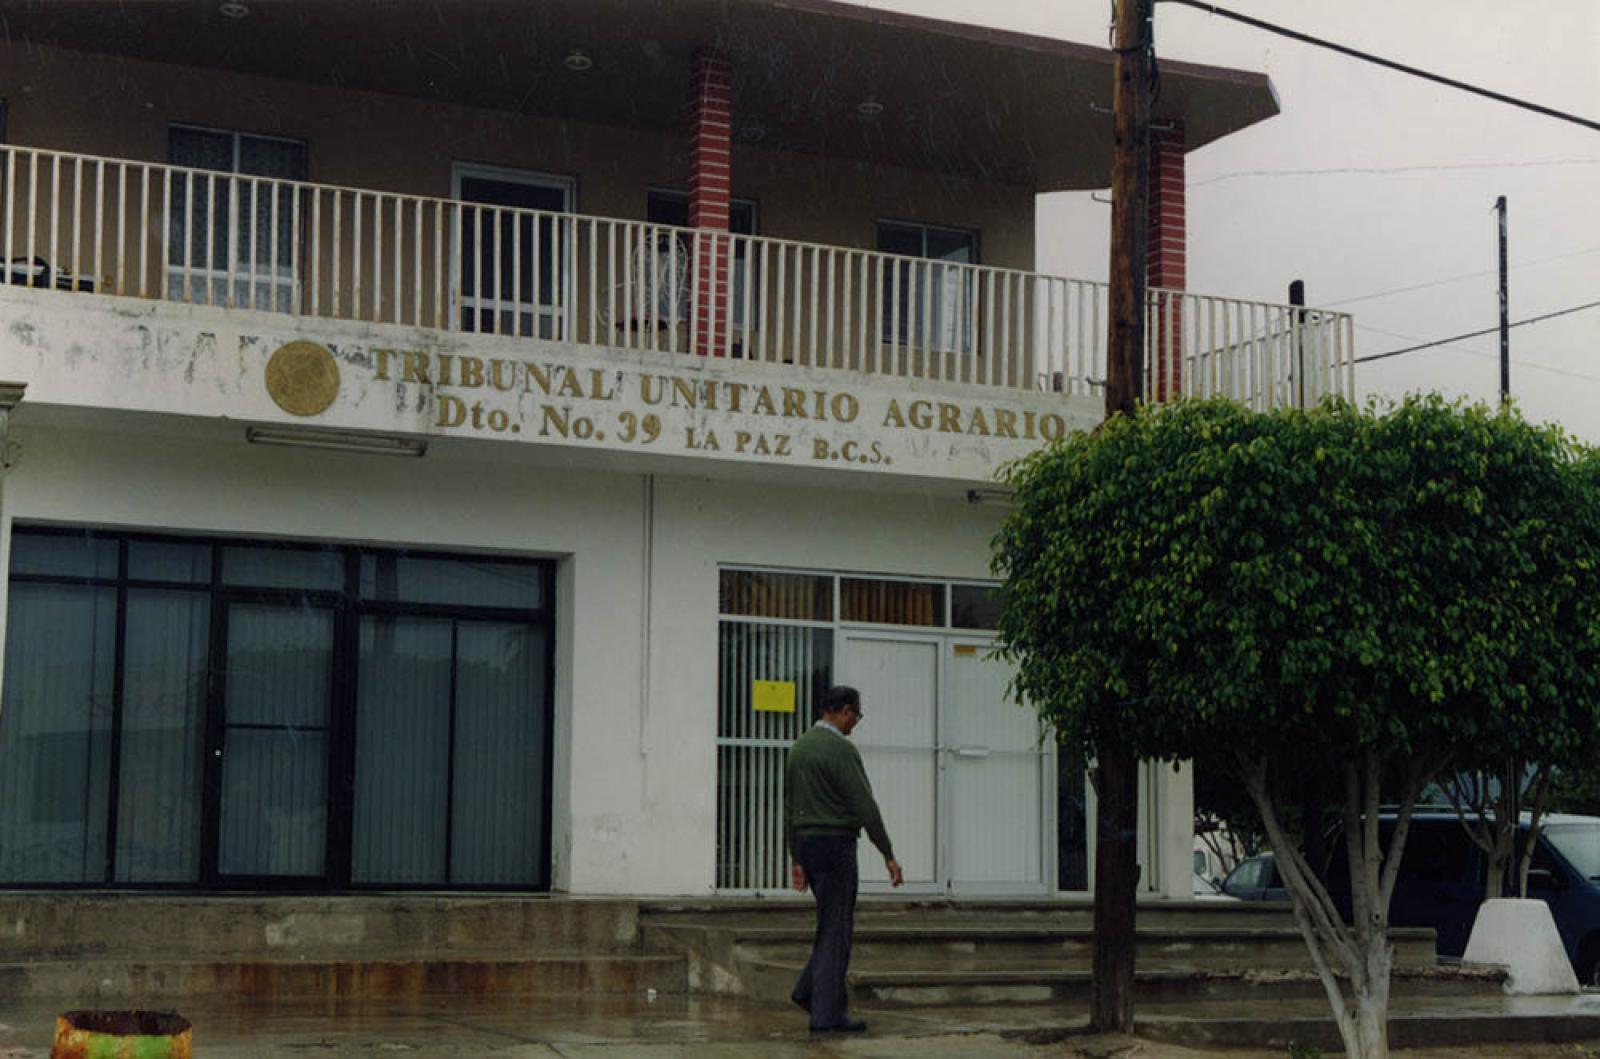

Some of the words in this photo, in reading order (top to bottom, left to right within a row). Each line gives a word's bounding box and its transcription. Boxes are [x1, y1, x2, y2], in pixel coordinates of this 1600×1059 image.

[368, 347, 614, 401] TRIBUNAL
[640, 372, 860, 423] UNITARIO
[882, 398, 1066, 442] AGRARIO
[435, 394, 521, 433] Dto.
[538, 404, 605, 440] No.
[616, 410, 662, 445] 39
[685, 426, 720, 450] LA
[734, 431, 792, 456] PAZ
[812, 435, 895, 465] B.C.S.
